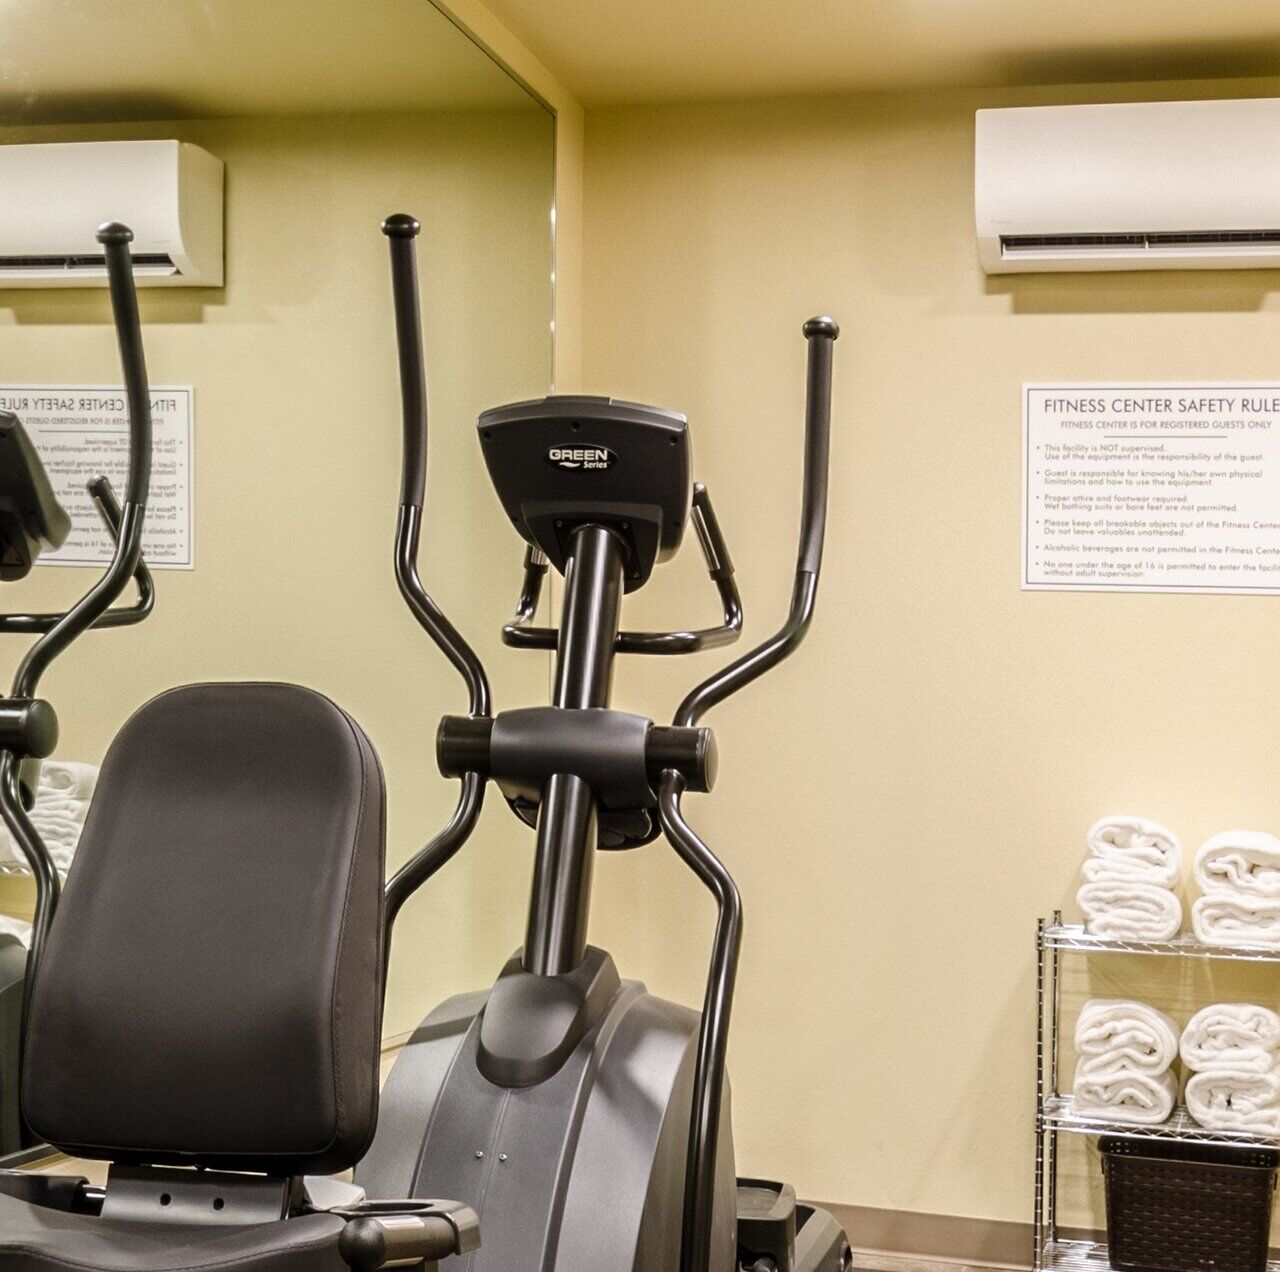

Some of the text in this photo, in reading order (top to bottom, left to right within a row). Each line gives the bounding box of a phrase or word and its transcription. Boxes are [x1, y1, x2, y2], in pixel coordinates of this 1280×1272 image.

[1045, 399, 1105, 413] FITNESS
[1112, 399, 1172, 412] CENTER
[1178, 398, 1235, 412] SAFETY
[1096, 421, 1128, 429] CENTER
[1130, 421, 1138, 429] IS
[1140, 421, 1157, 429] FOR
[1160, 421, 1209, 429] REGISTERED
[1212, 421, 1245, 429] GUESTS
[1248, 421, 1272, 429] ONLY
[1045, 444, 1060, 452] This
[1063, 444, 1088, 454] facility
[1100, 444, 1118, 452] NOT
[549, 449, 608, 462] GREEN
[1088, 454, 1130, 462] equipment
[1142, 453, 1154, 461] the
[1157, 453, 1211, 462] responsibility
[1214, 453, 1222, 461] of
[1045, 469, 1068, 477] Guest
[1079, 469, 1125, 479] responsible
[1128, 469, 1138, 477] for
[1141, 470, 1175, 479] knowing
[1178, 470, 1207, 478] his/her
[1229, 471, 1262, 480] physical
[1045, 478, 1086, 486] limitations
[1088, 478, 1103, 486] and
[1106, 478, 1123, 486] how
[1126, 478, 1133, 486] to
[1152, 478, 1165, 486] the
[1044, 494, 1070, 503] Proper
[1072, 494, 1093, 502] attire
[1096, 494, 1111, 502] and
[1062, 503, 1092, 511] bathing
[1044, 519, 1069, 527] Please
[1072, 519, 1091, 528] keep
[1106, 520, 1146, 528] breakable
[1149, 521, 1177, 529] objects
[1222, 521, 1250, 529] Fitness
[1097, 528, 1135, 536] valuables
[1082, 545, 1123, 554] beverages
[1158, 546, 1196, 554] permitted
[1117, 563, 1131, 571] age
[1167, 563, 1205, 571] permitted
